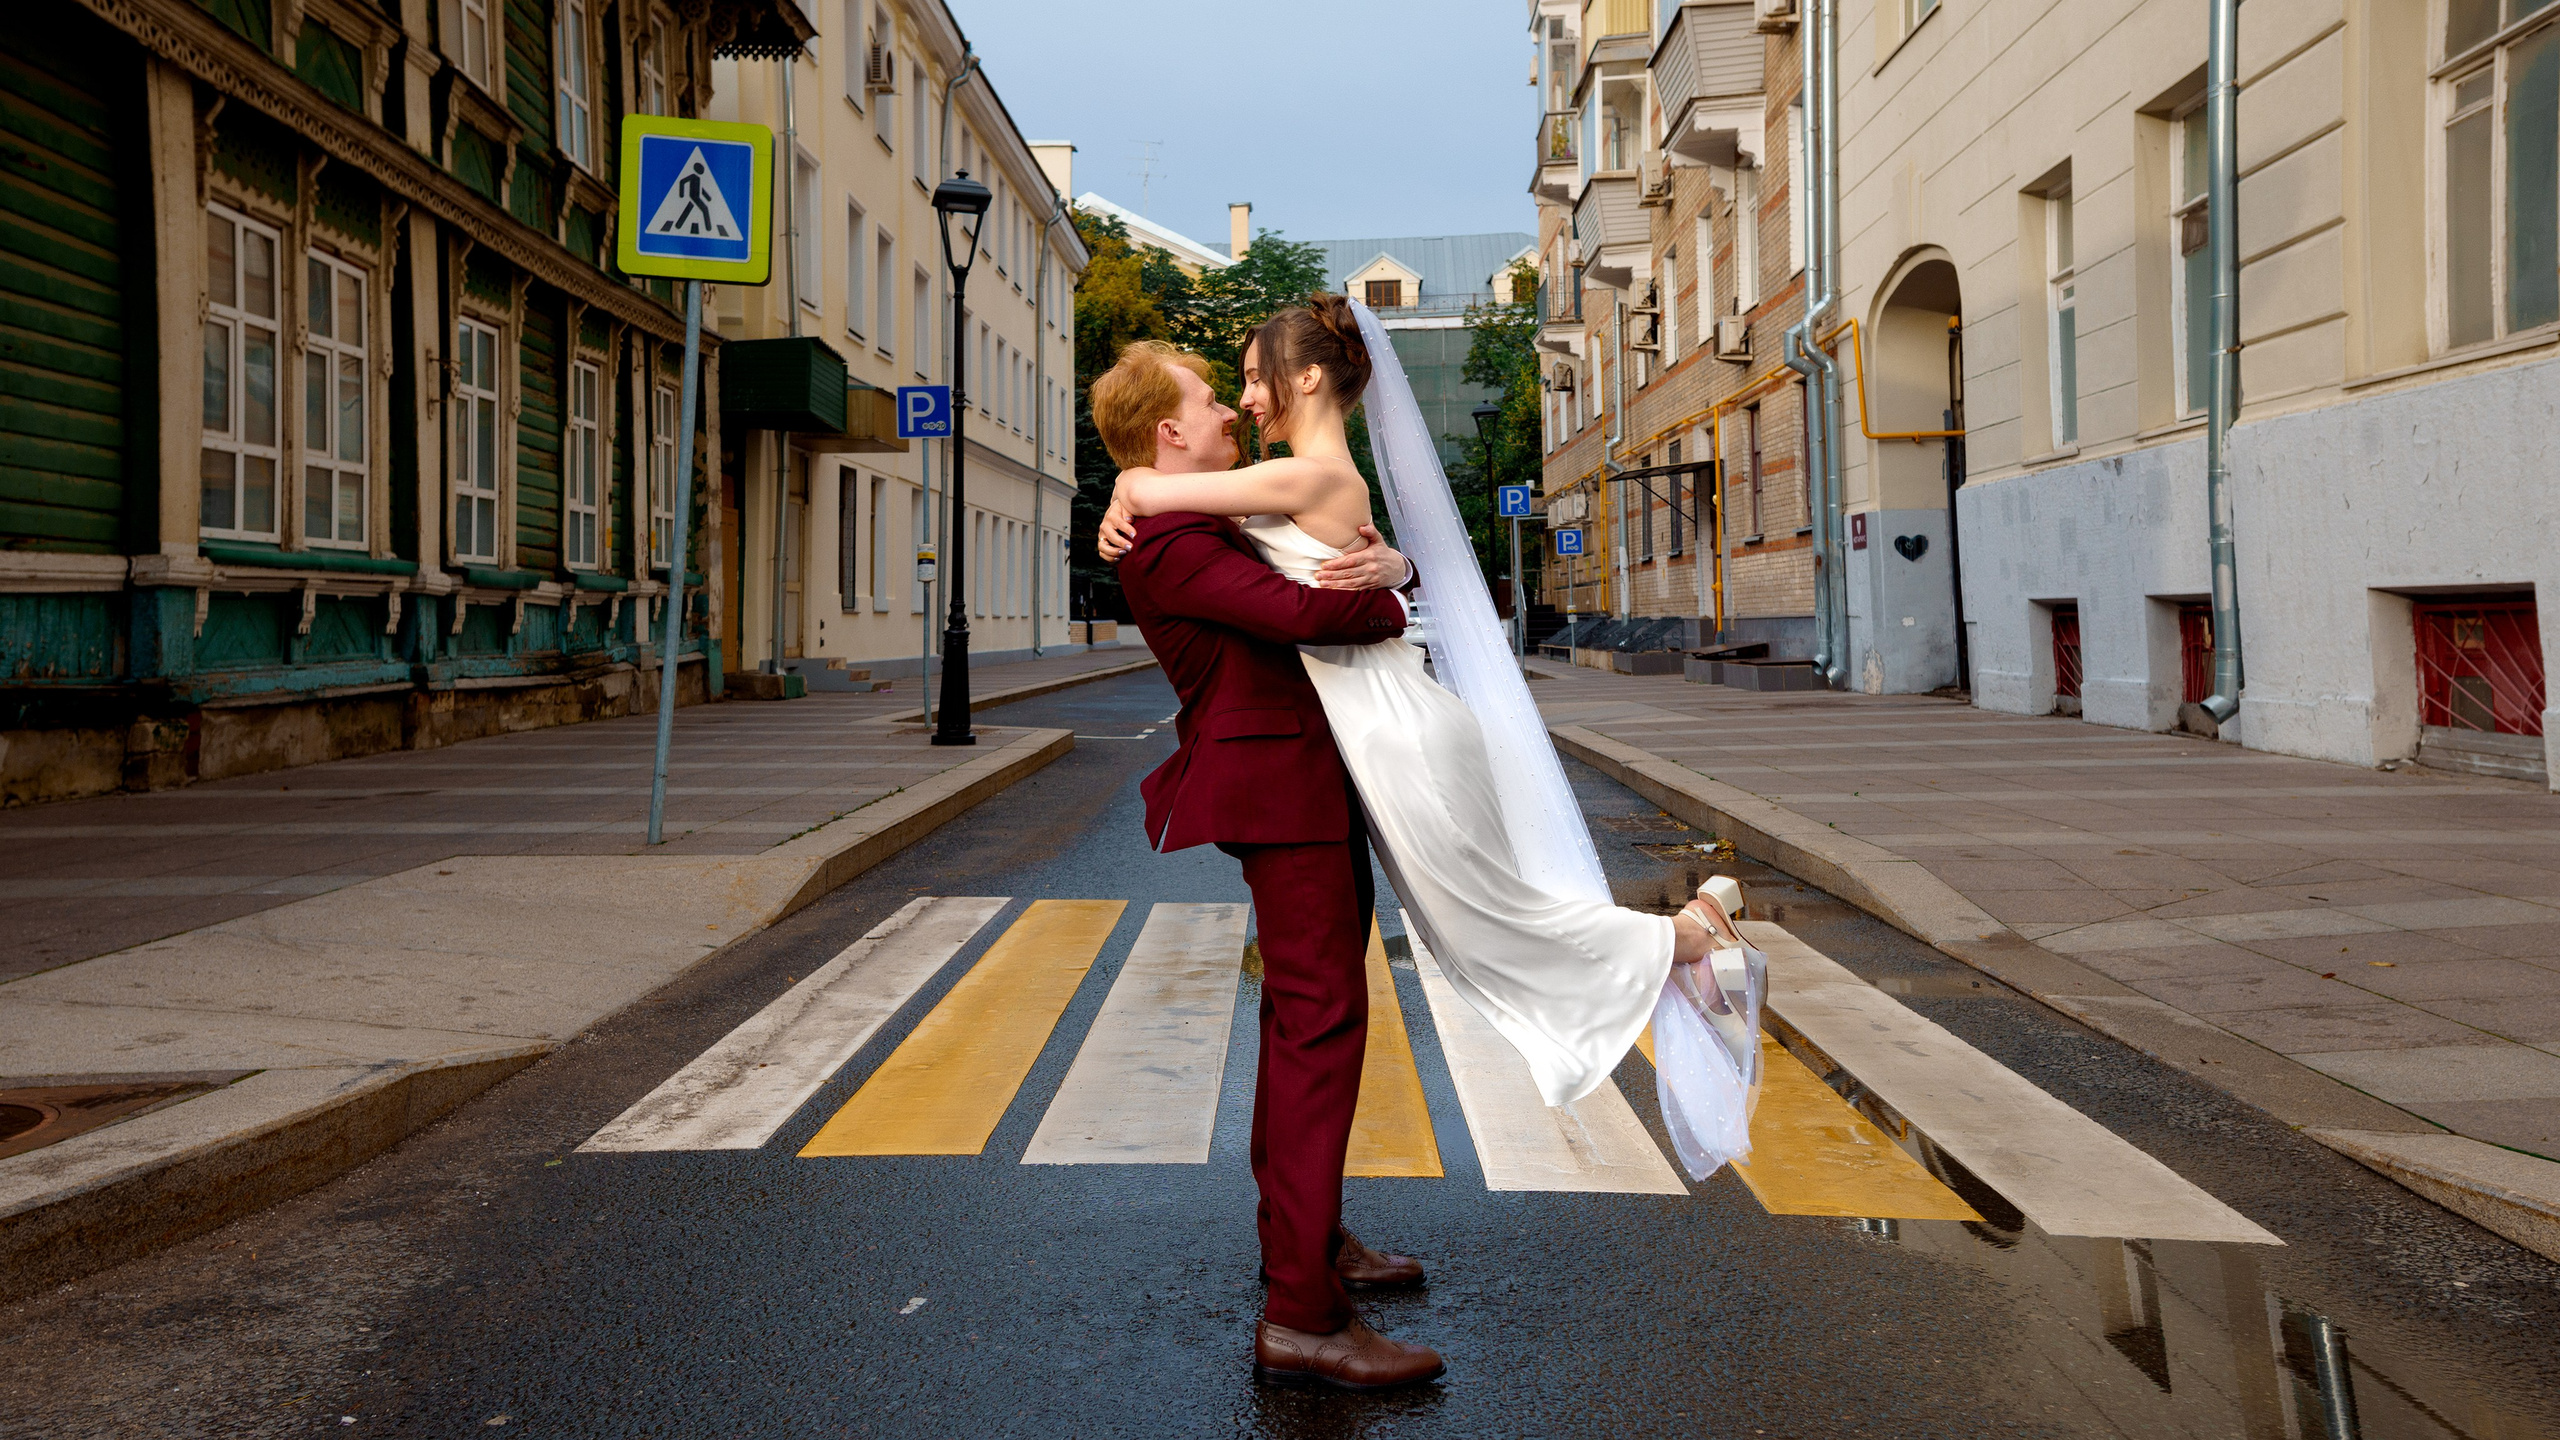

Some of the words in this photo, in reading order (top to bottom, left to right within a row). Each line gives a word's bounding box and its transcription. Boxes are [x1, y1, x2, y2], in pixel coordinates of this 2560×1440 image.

[907, 392, 935, 432] P
[1507, 490, 1523, 512] P
[1563, 533, 1576, 551] P
